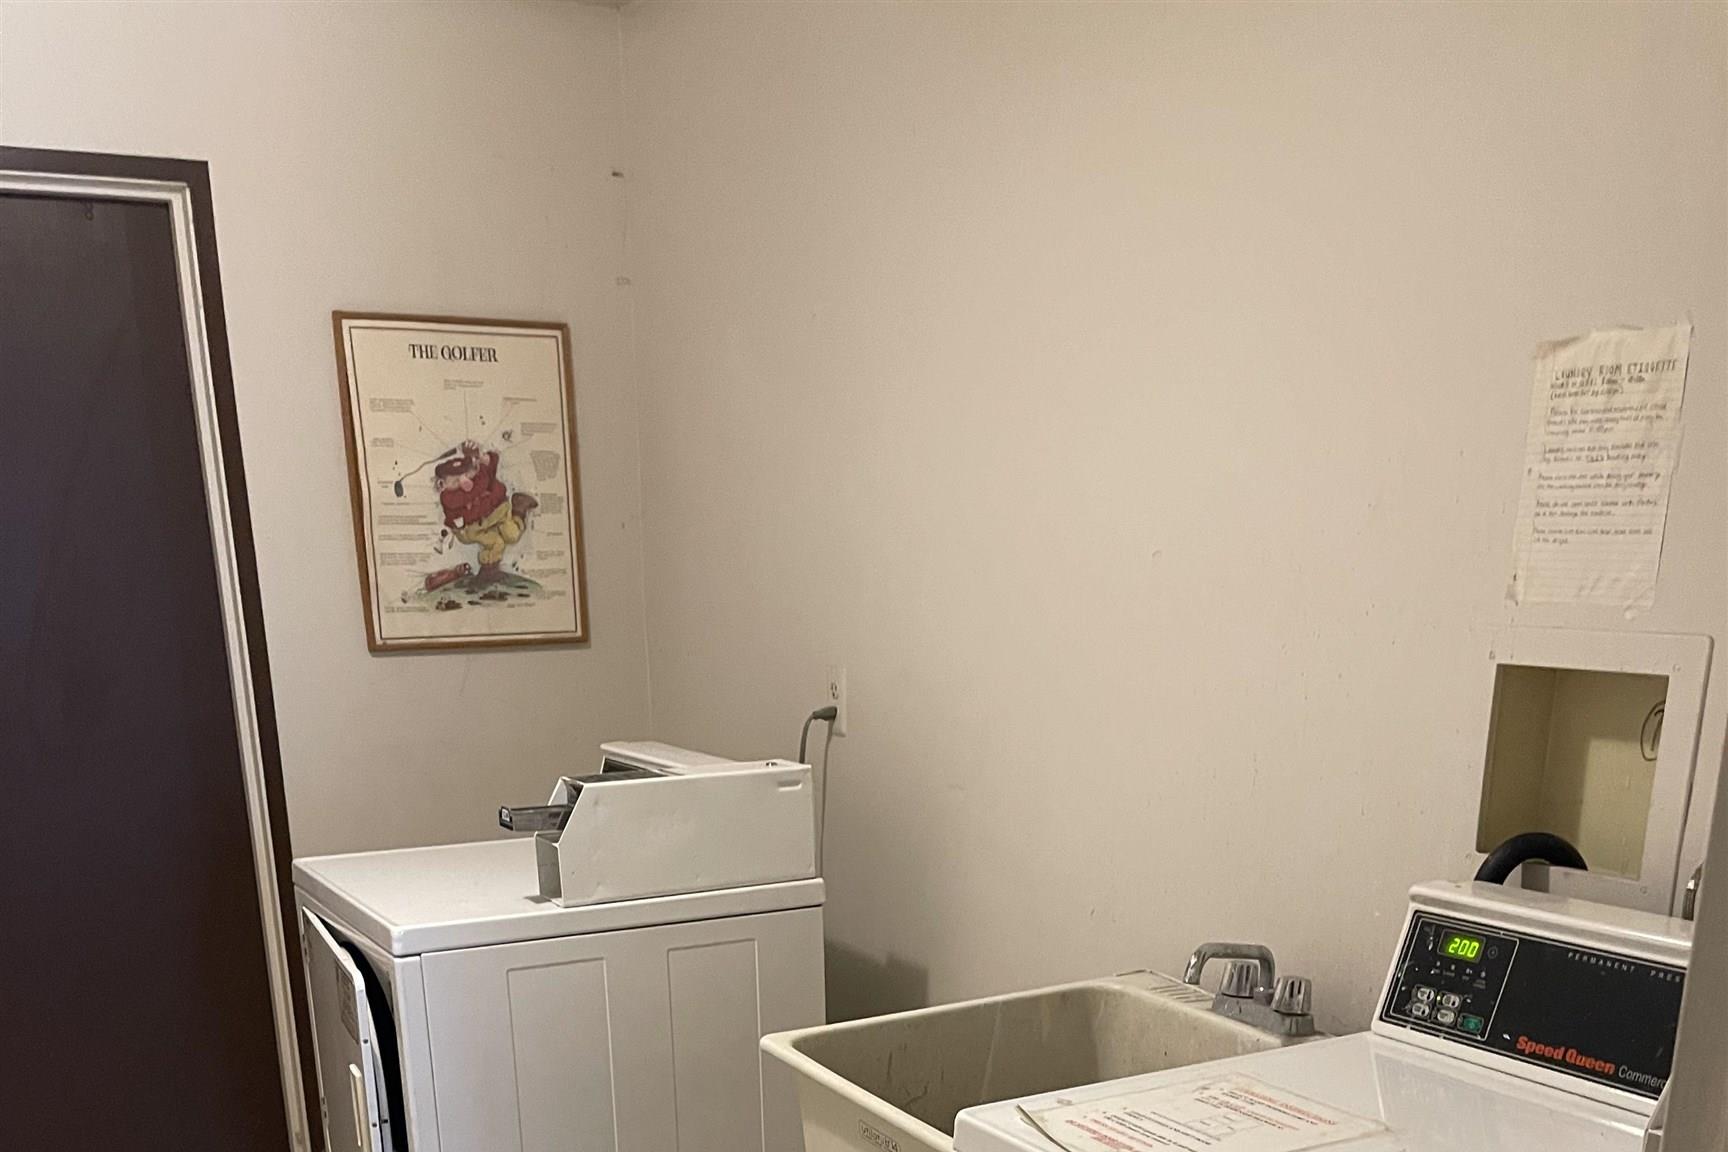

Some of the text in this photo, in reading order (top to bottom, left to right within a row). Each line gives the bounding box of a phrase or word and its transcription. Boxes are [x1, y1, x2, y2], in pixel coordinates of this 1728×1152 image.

[408, 343, 499, 362] THE GOLFER
[1448, 937, 1480, 959] 200
[1567, 951, 1635, 974] PERMANENT
[1516, 1035, 1565, 1060] Speed
[1565, 1048, 1616, 1075] Queen
